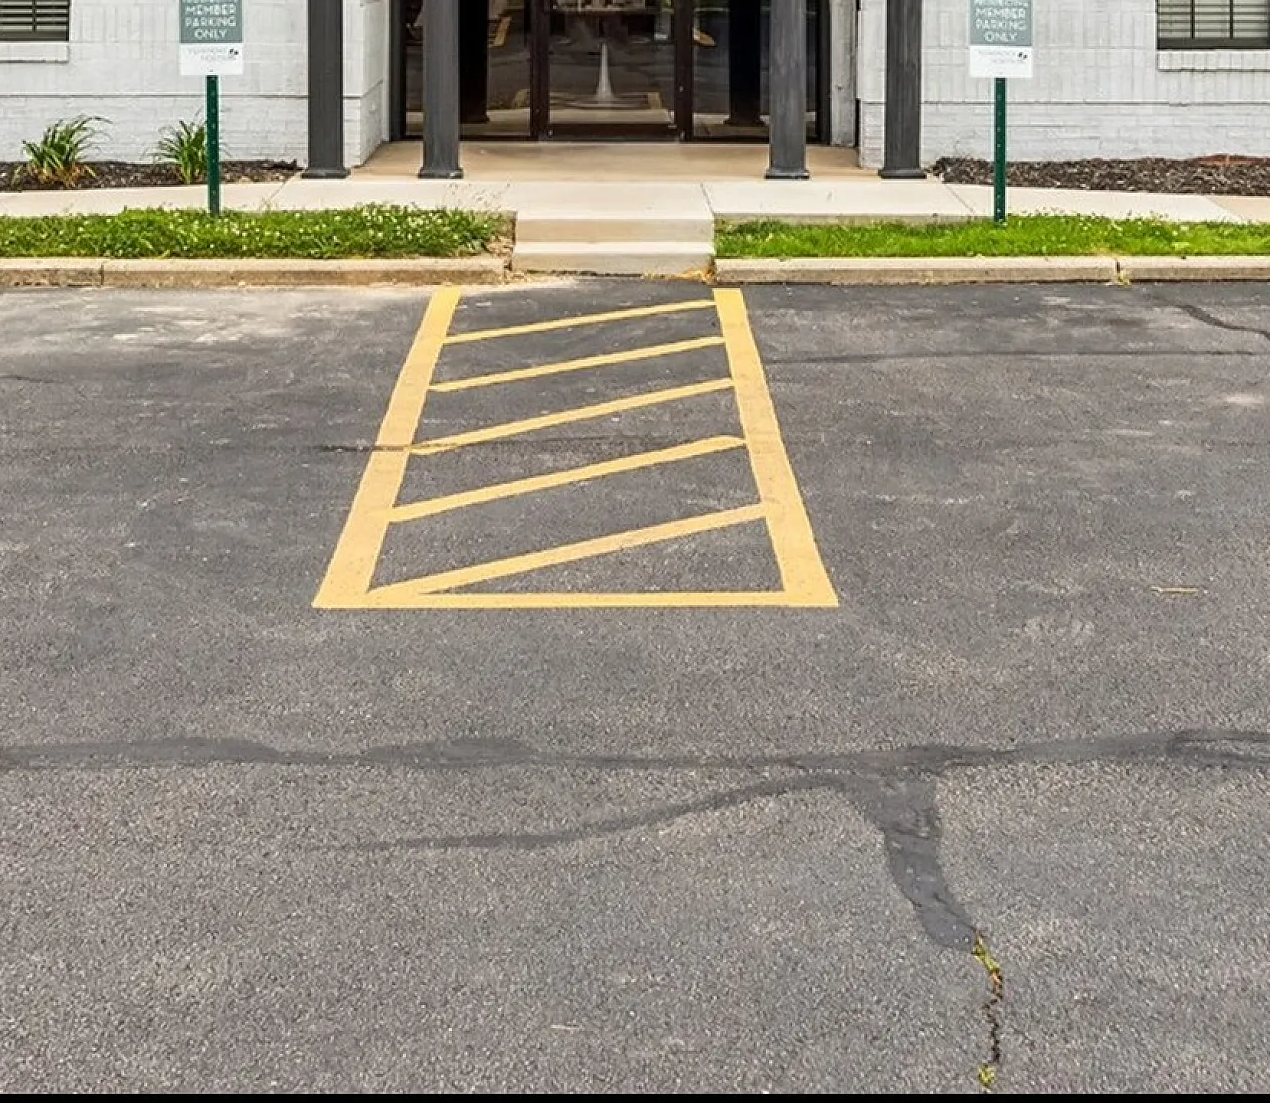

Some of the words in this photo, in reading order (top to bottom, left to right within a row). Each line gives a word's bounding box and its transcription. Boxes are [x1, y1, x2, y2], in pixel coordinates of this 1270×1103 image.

[184, 4, 237, 16] MEMBER
[975, 7, 1026, 19] MEMBER
[184, 17, 237, 27] PARKING
[975, 19, 1028, 30] PARKING
[193, 29, 227, 39] ONLY
[983, 31, 1017, 42] ONLY
